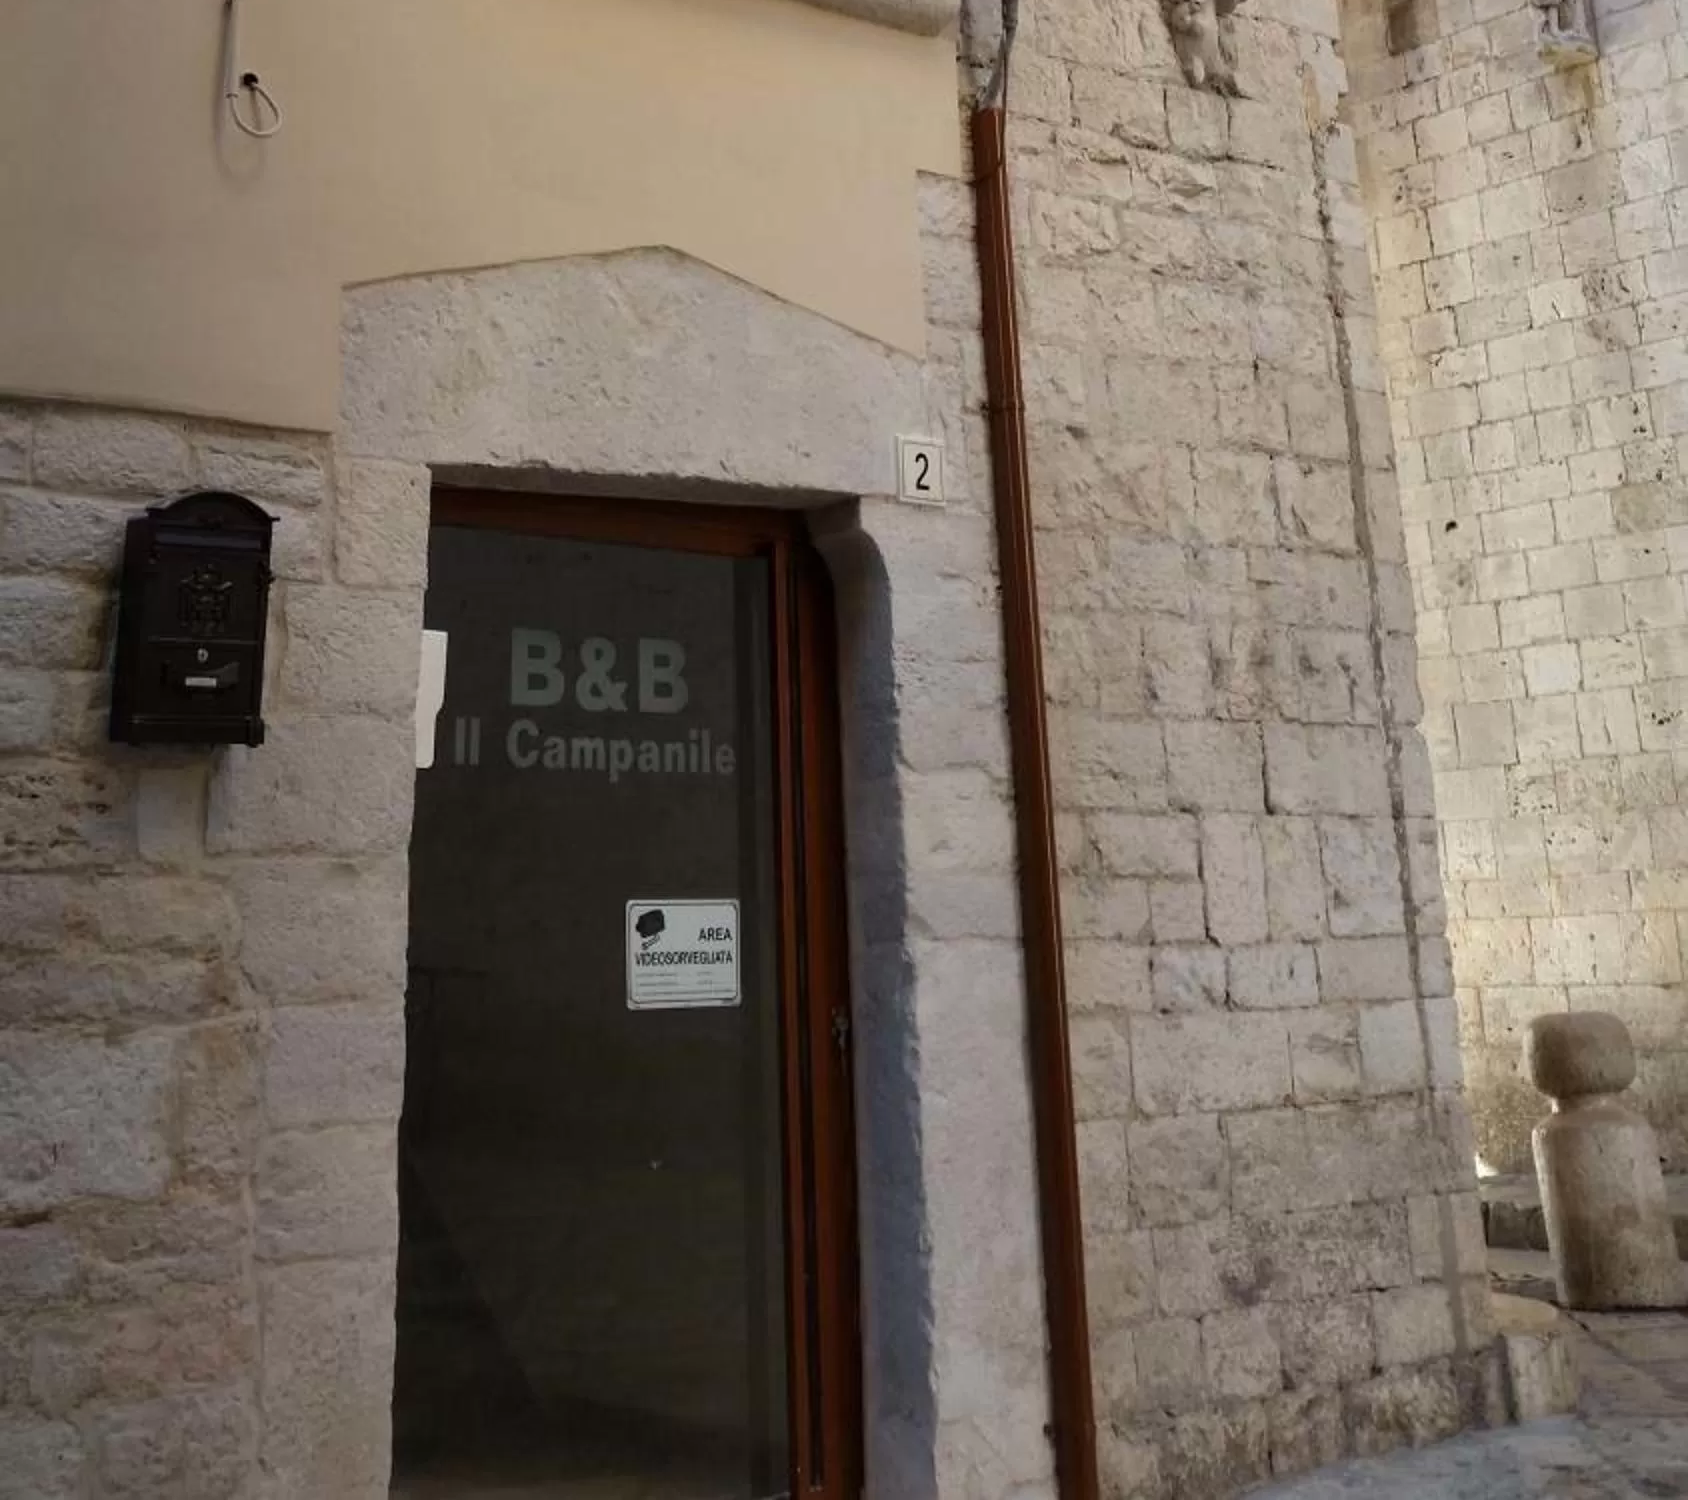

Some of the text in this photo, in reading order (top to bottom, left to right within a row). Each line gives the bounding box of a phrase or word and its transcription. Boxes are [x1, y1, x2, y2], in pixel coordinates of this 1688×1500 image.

[915, 452, 930, 491] 2
[511, 627, 689, 714] B&B
[506, 718, 736, 783] Campanile
[698, 927, 733, 941] AREA
[634, 951, 733, 966] VIDEOSORVEGLIATA
